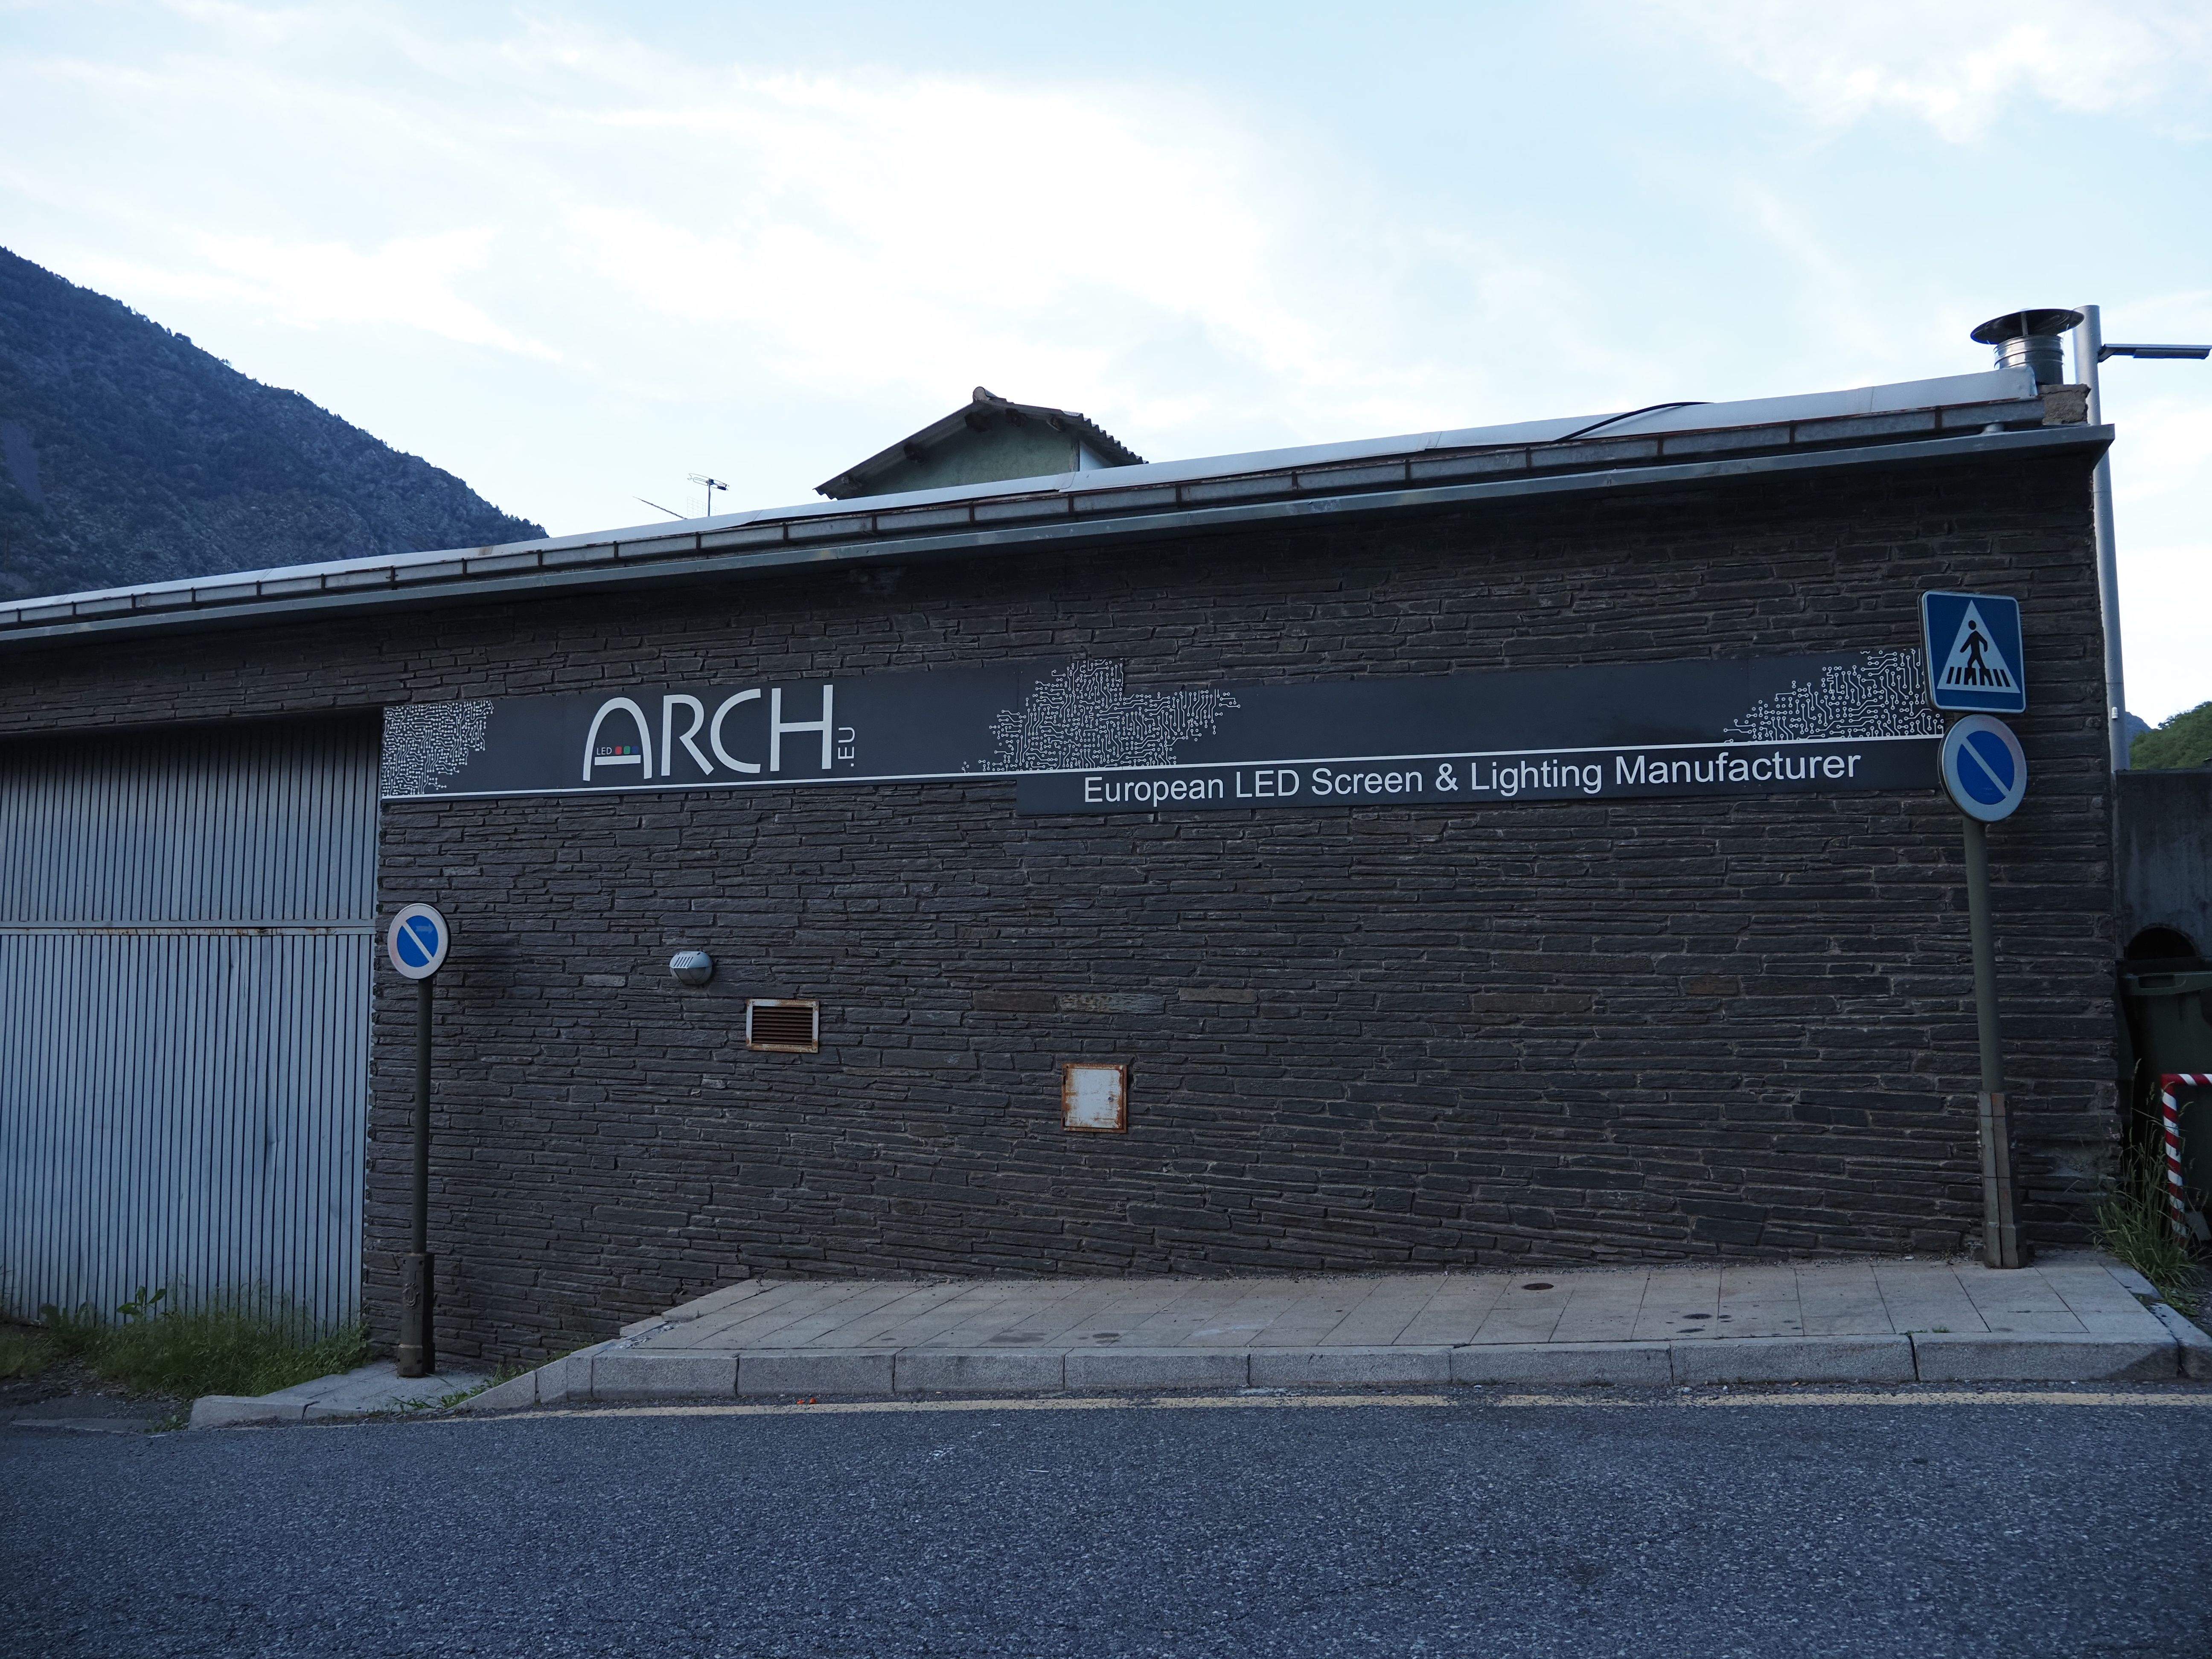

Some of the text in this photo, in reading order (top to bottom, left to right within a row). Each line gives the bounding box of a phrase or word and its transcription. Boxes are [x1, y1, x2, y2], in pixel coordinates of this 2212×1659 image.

[583, 684, 834, 782] ARCH
[597, 747, 612, 755] LED
[838, 727, 855, 767] .EU
[1084, 751, 1862, 808] European LED Screen & Lighting Manufacturer
